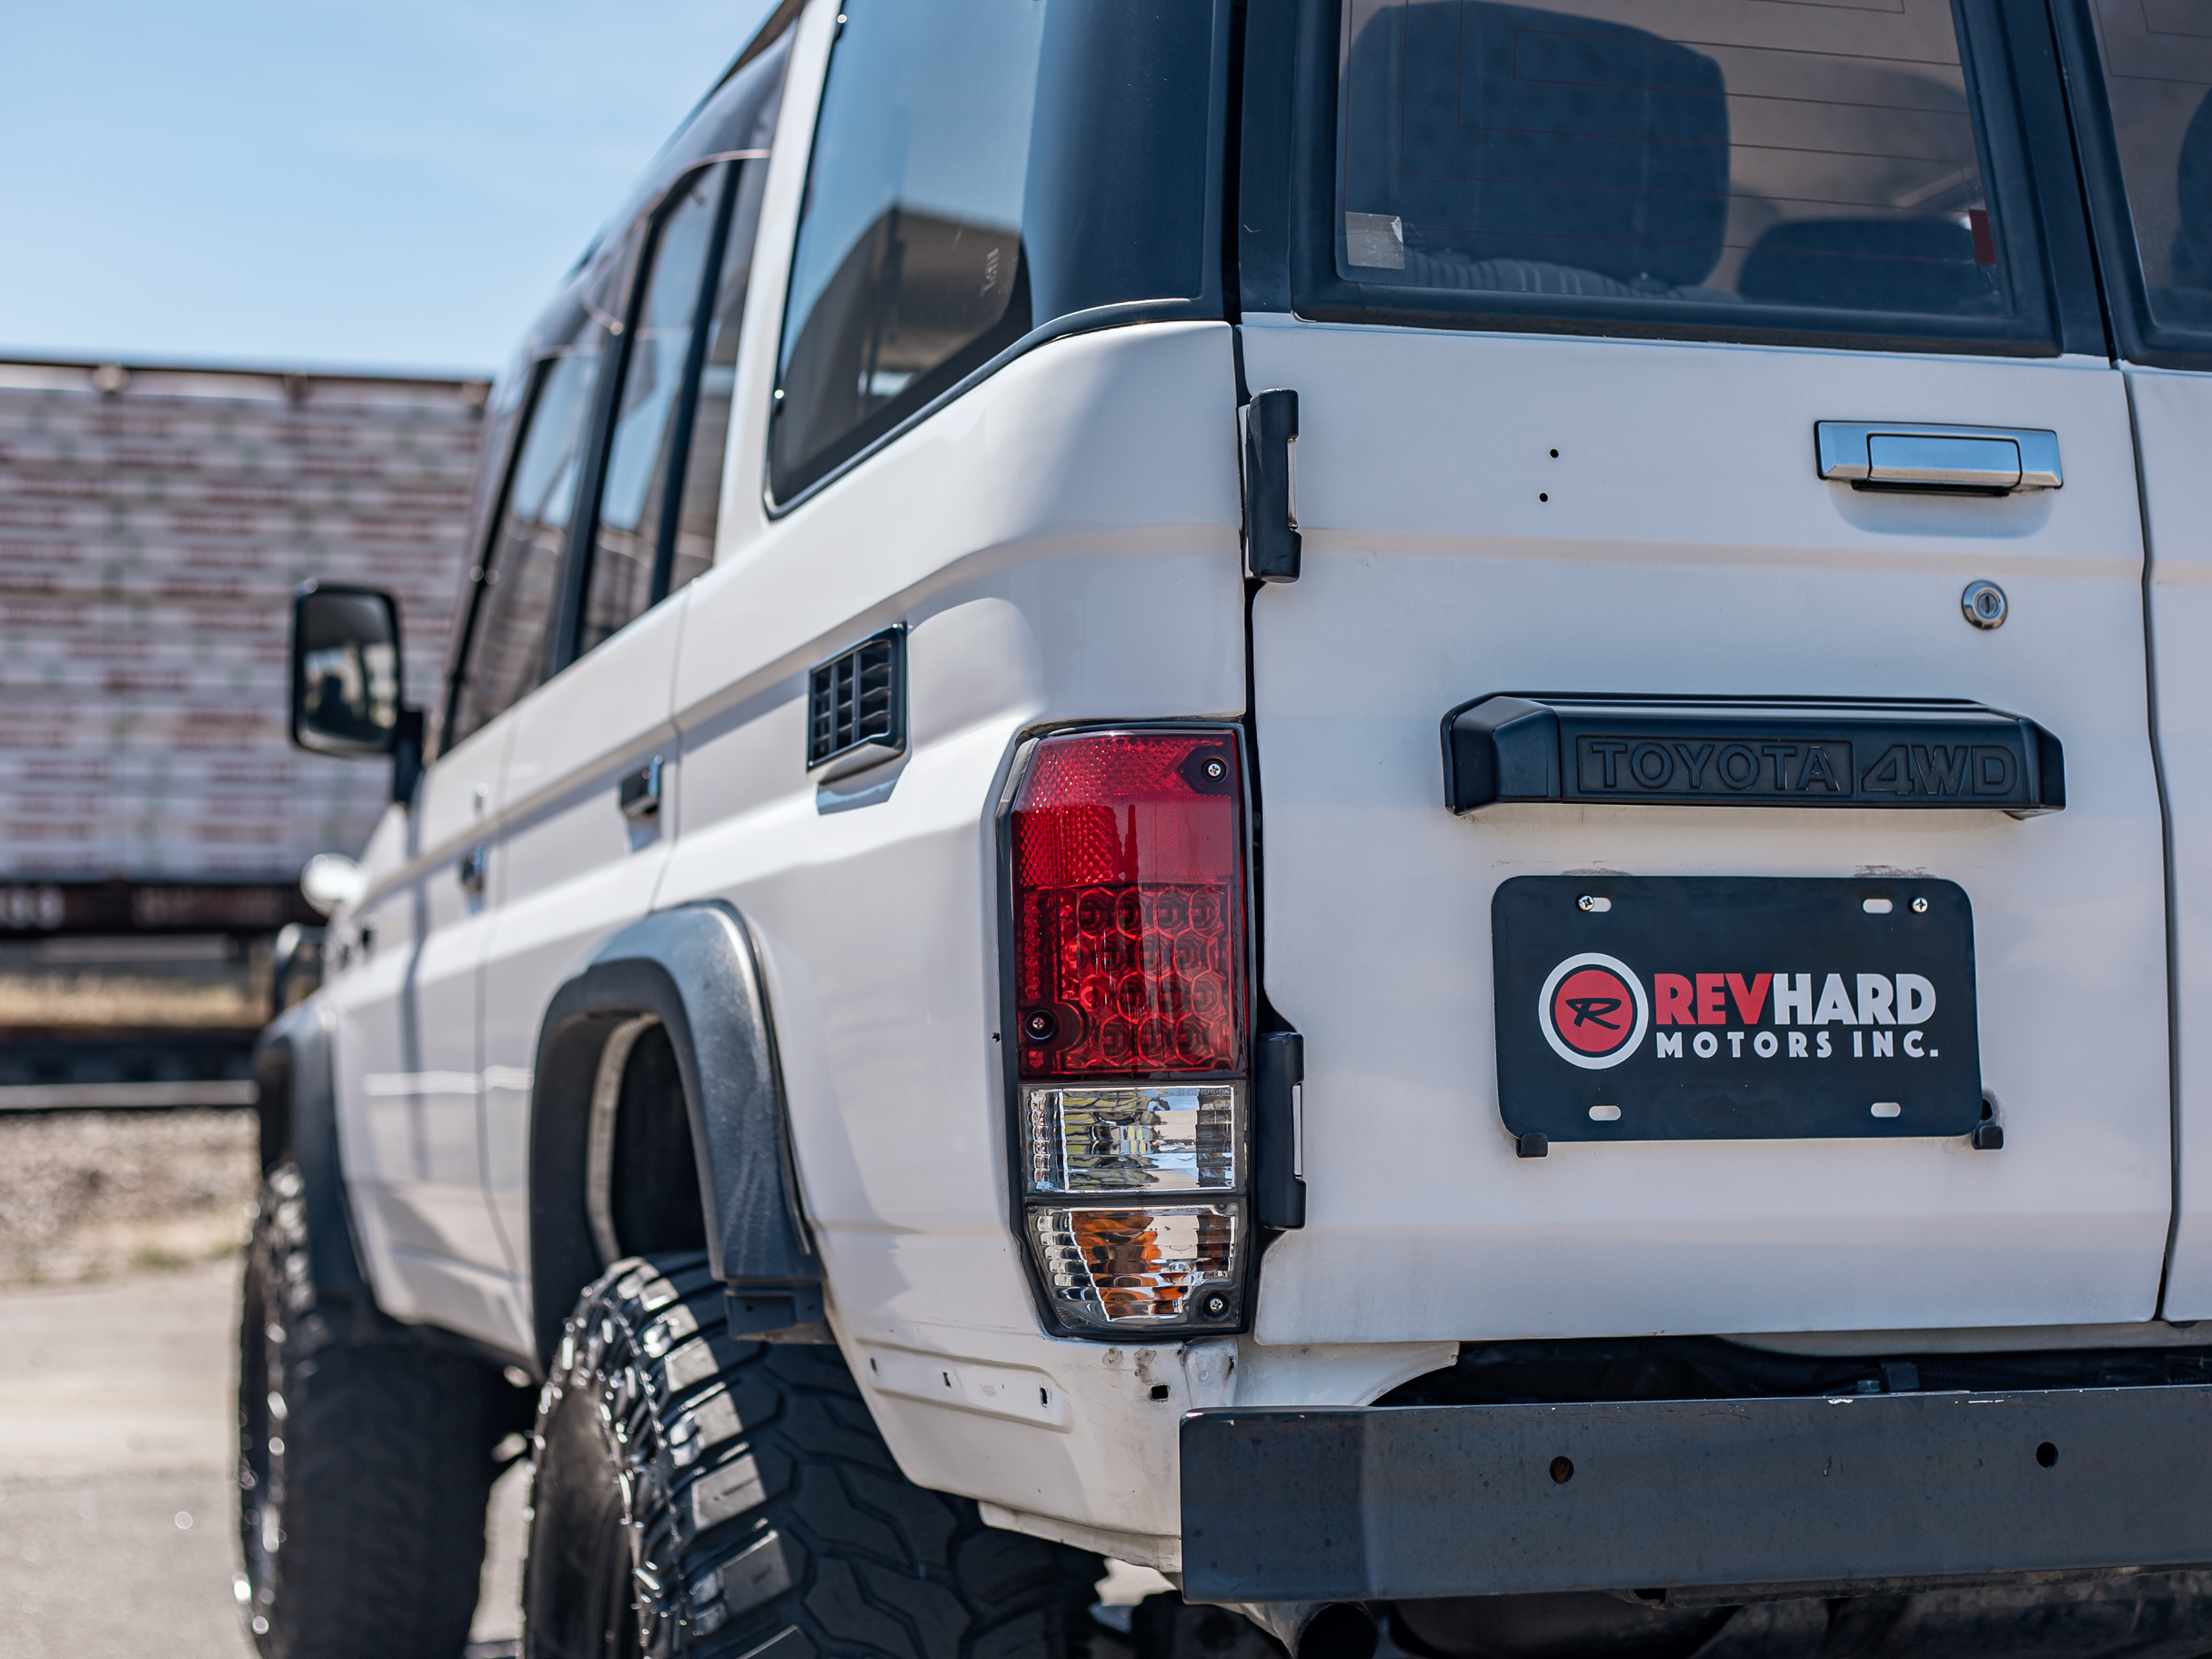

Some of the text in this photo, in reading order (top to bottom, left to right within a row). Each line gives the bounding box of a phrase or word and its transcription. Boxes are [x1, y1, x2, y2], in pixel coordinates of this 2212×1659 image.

[1592, 741, 2017, 795] TOYOTA 4WD
[1142, 883, 1171, 893] DEPO
[1564, 997, 1622, 1030] R
[1654, 972, 1936, 1025] REVHARD
[1655, 1030, 1939, 1059] MOTORS INC.
